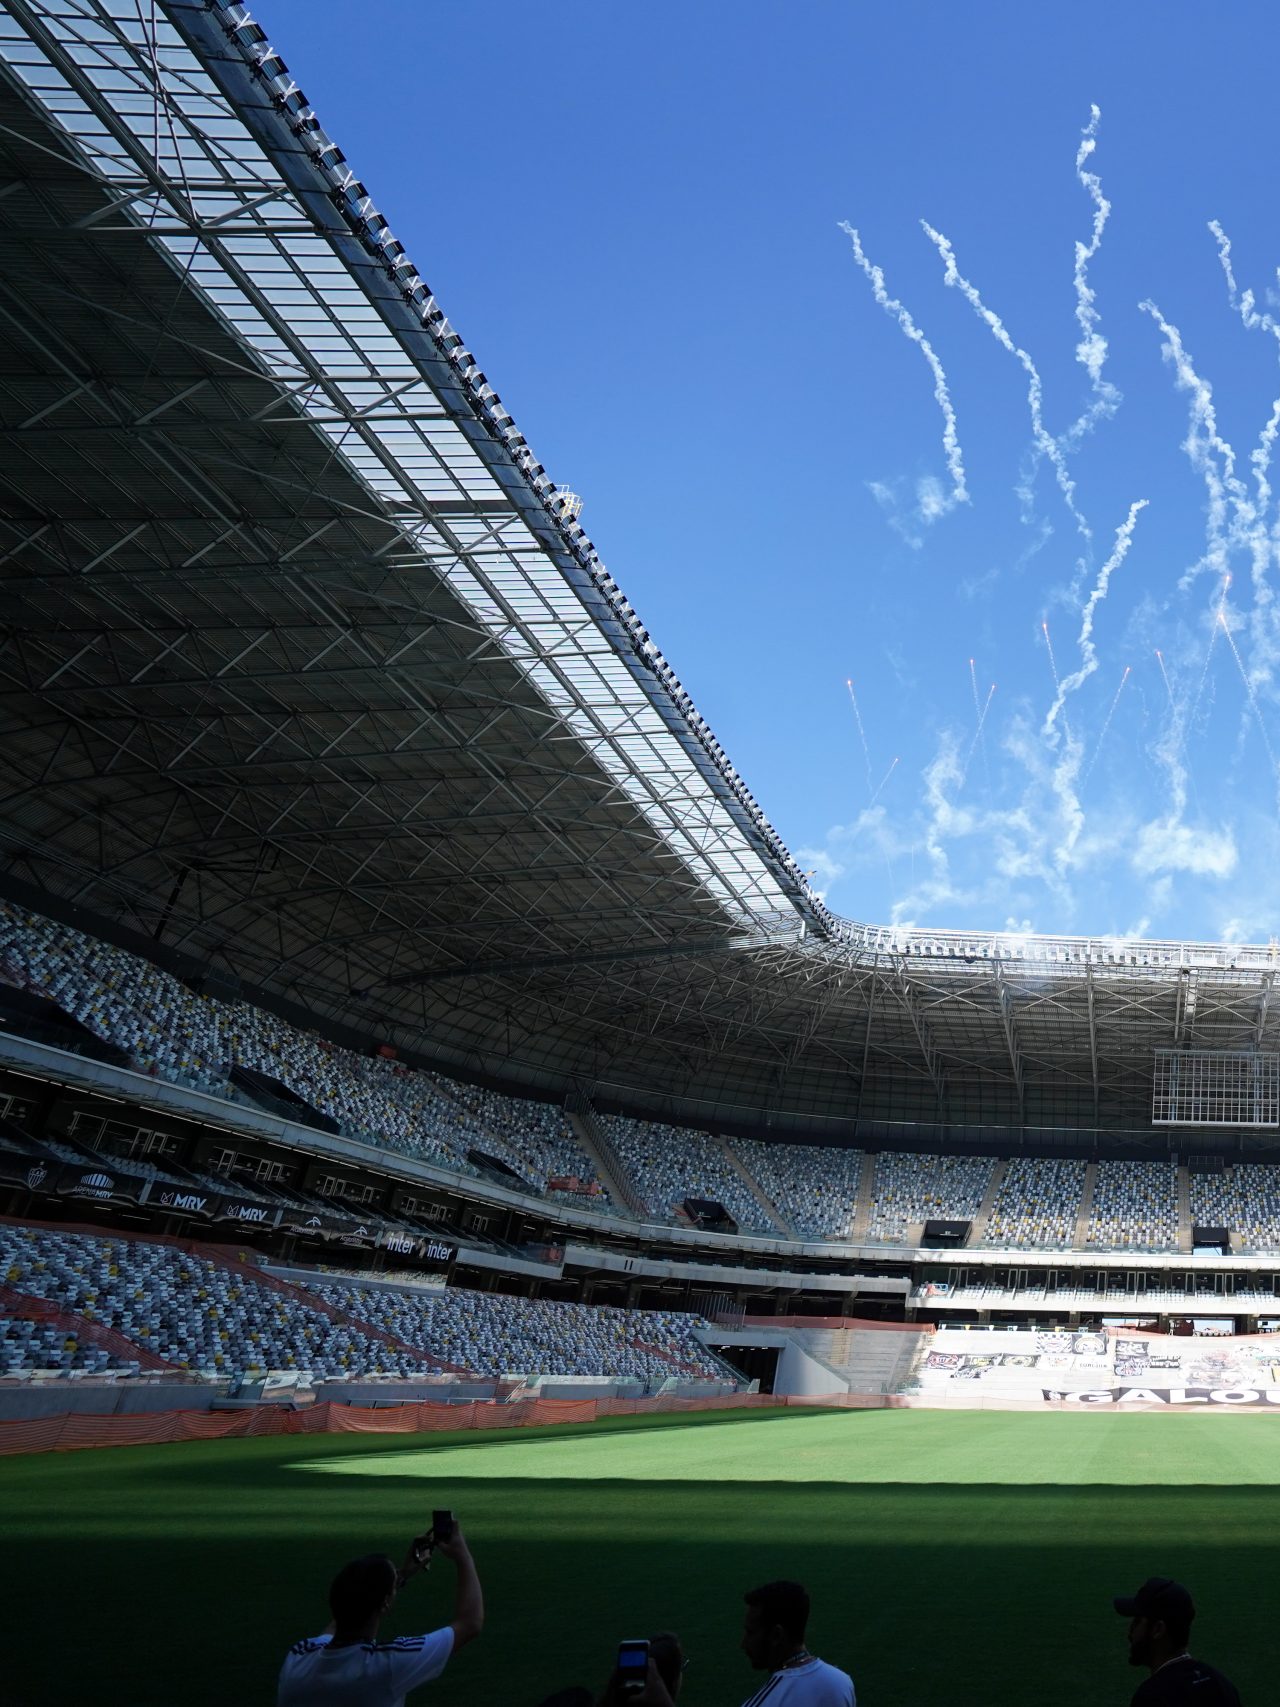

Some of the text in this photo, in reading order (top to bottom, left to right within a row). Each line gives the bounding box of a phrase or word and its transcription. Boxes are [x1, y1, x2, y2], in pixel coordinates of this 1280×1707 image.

[173, 1193, 208, 1211] MRV
[238, 1206, 268, 1222] MRV
[387, 1233, 416, 1255] inter
[427, 1240, 453, 1261] inter
